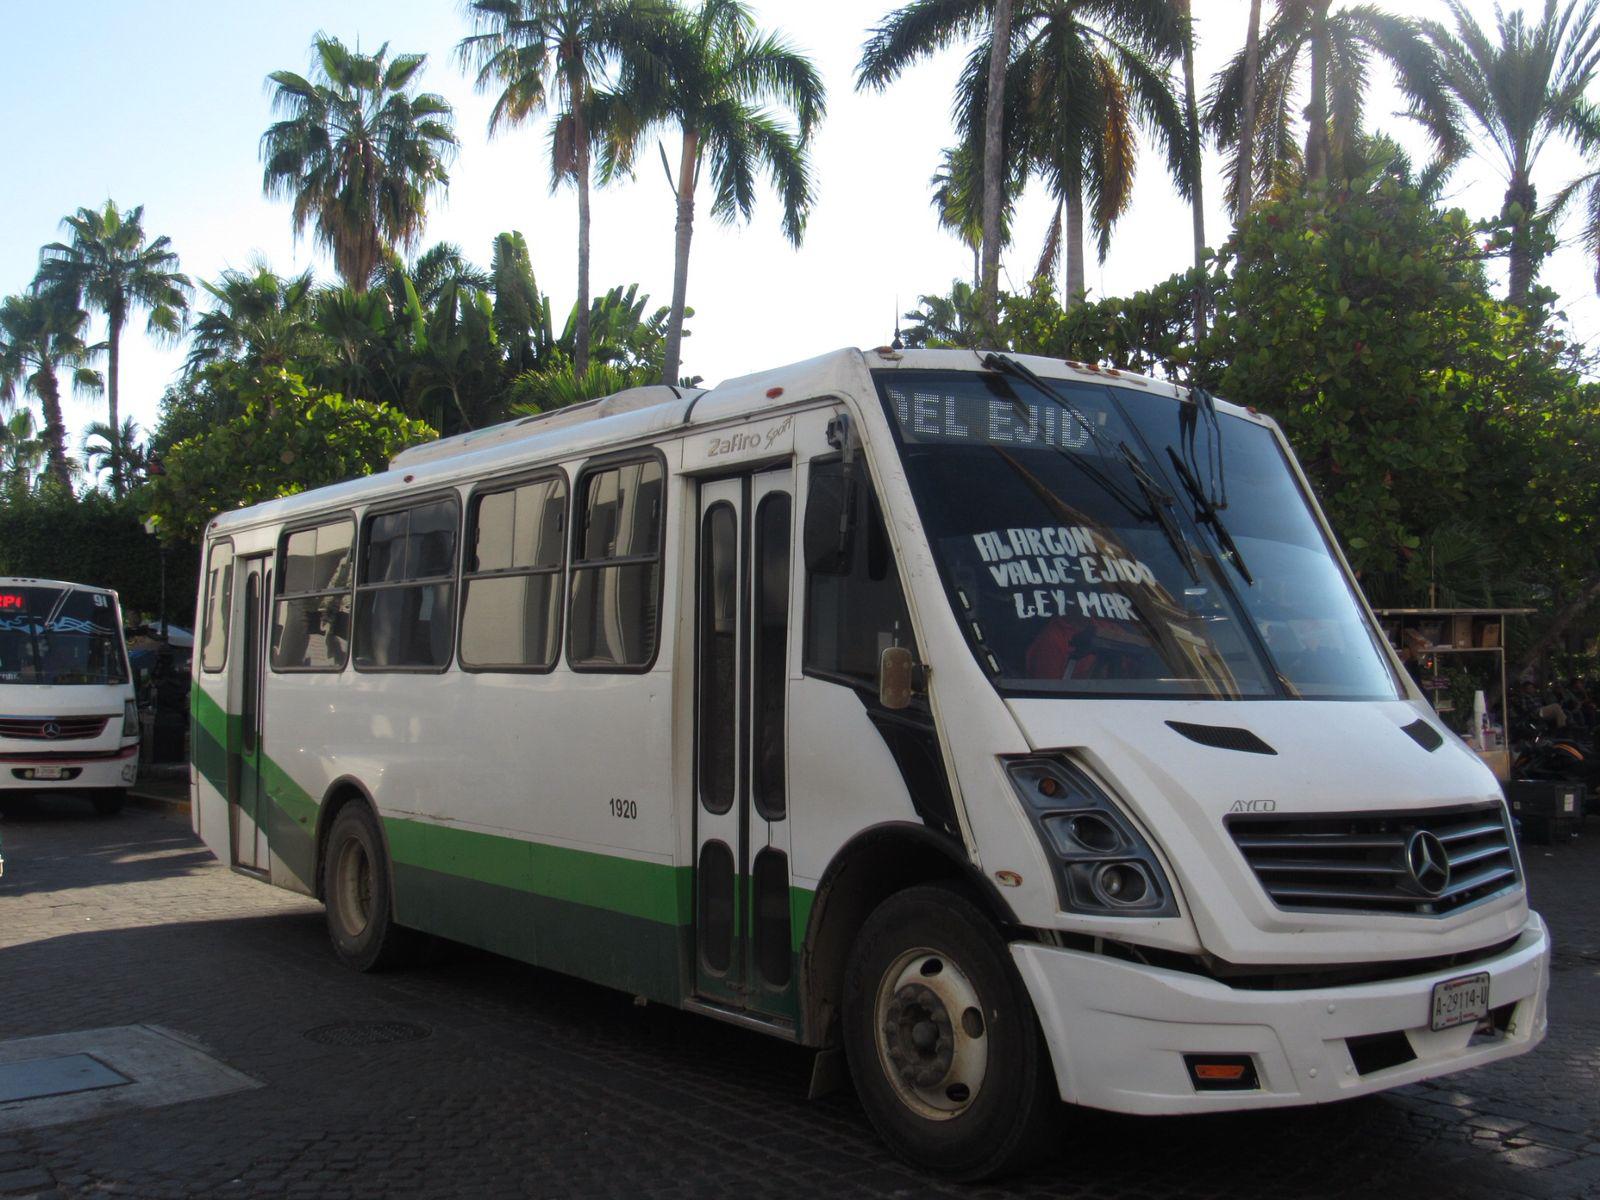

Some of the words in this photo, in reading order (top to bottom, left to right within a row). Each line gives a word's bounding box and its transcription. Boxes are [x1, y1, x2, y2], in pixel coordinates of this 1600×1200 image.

[988, 400, 1096, 448] EJID
[708, 433, 762, 457] Zafiro
[609, 797, 638, 820] 1920
